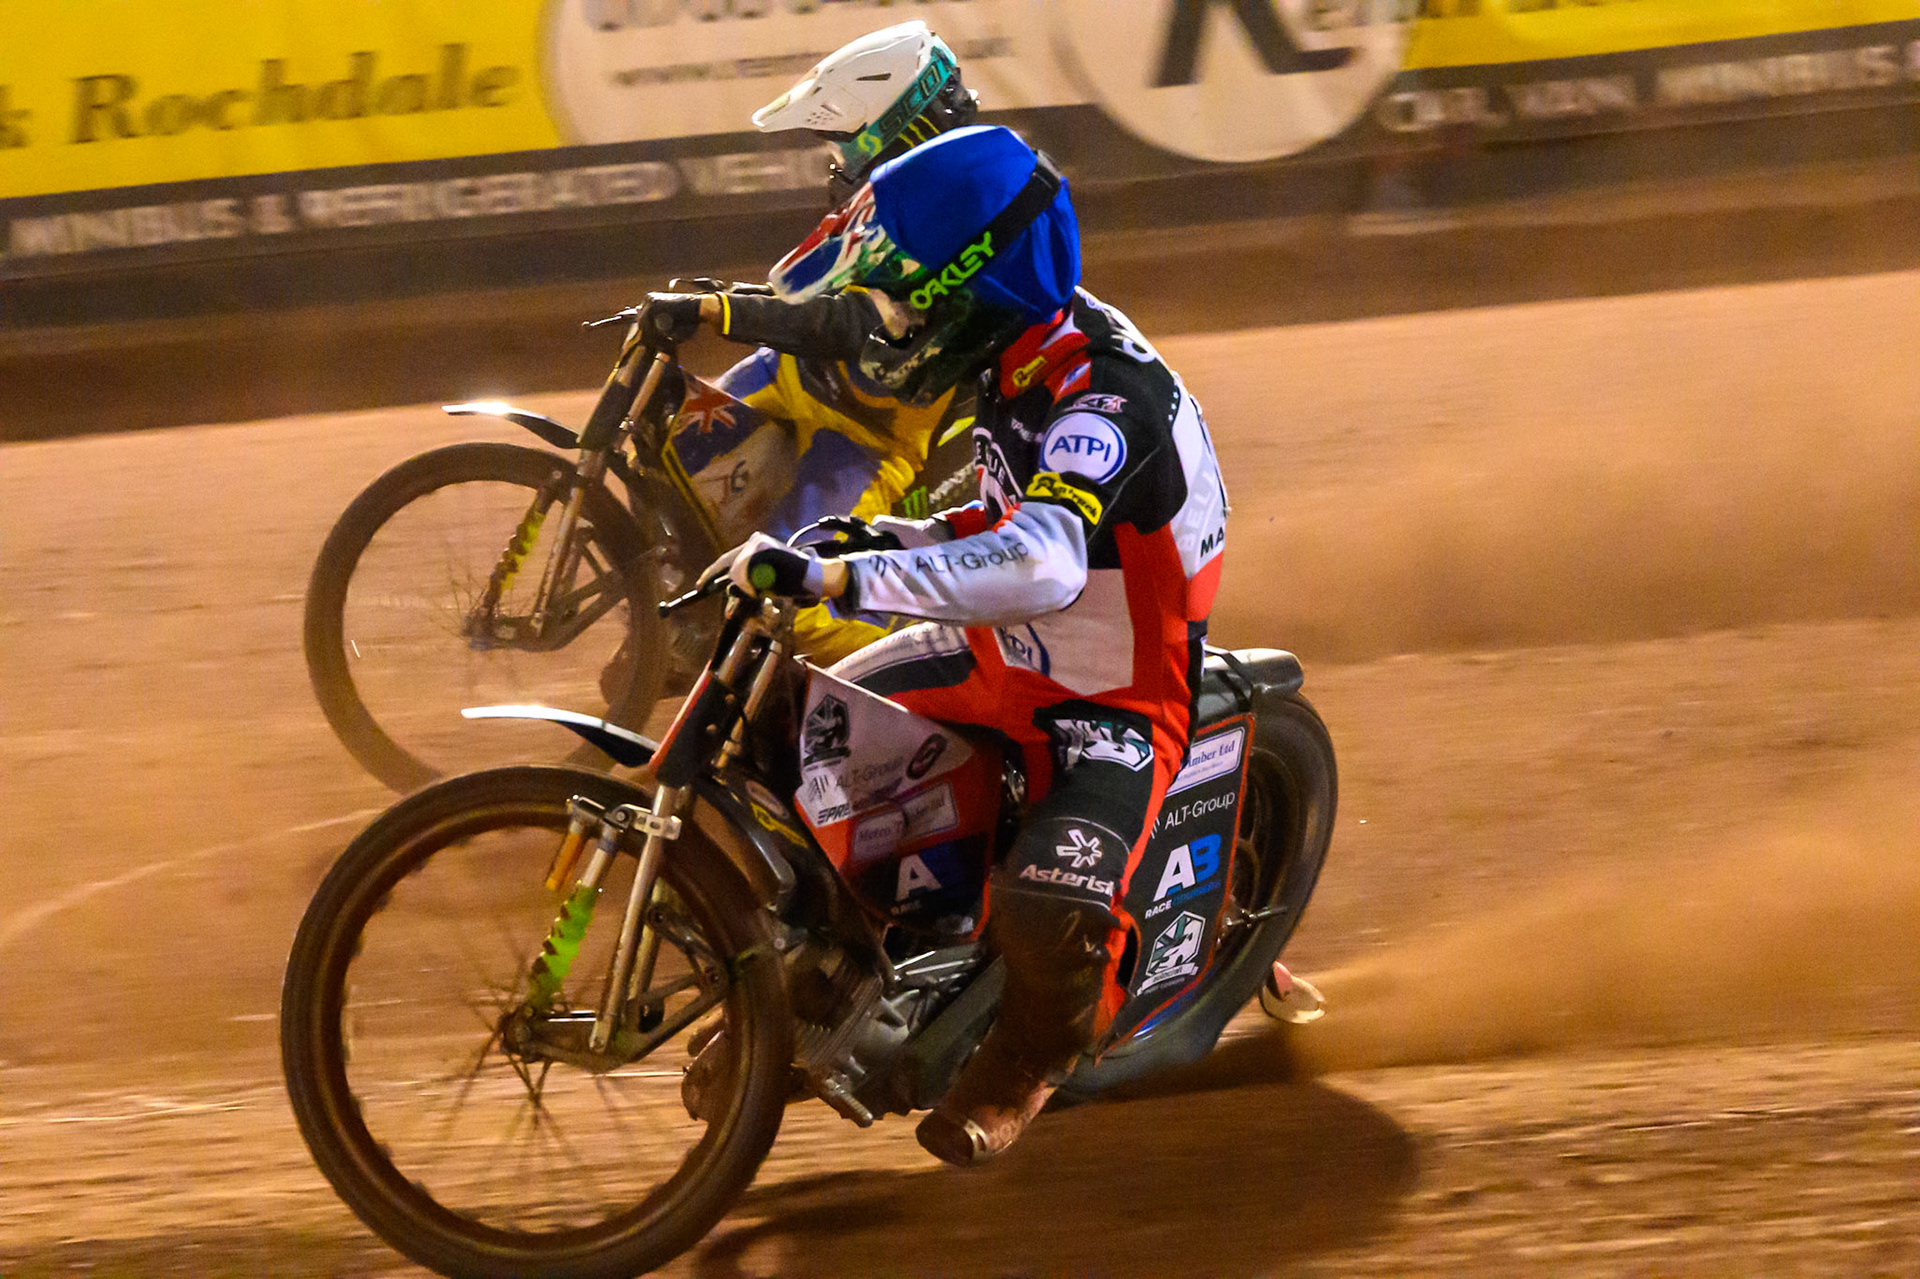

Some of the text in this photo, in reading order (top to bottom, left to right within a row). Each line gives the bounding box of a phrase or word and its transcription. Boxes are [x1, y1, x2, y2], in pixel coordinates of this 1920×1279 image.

[71, 43, 519, 145] Rochdale
[910, 231, 995, 310] OAKLEY
[1050, 434, 1112, 463] ATPI
[916, 542, 1029, 574] ALT-Group
[1164, 791, 1236, 831] ALT-Group
[1153, 833, 1222, 903] AB
[1145, 899, 1173, 920] RACE
